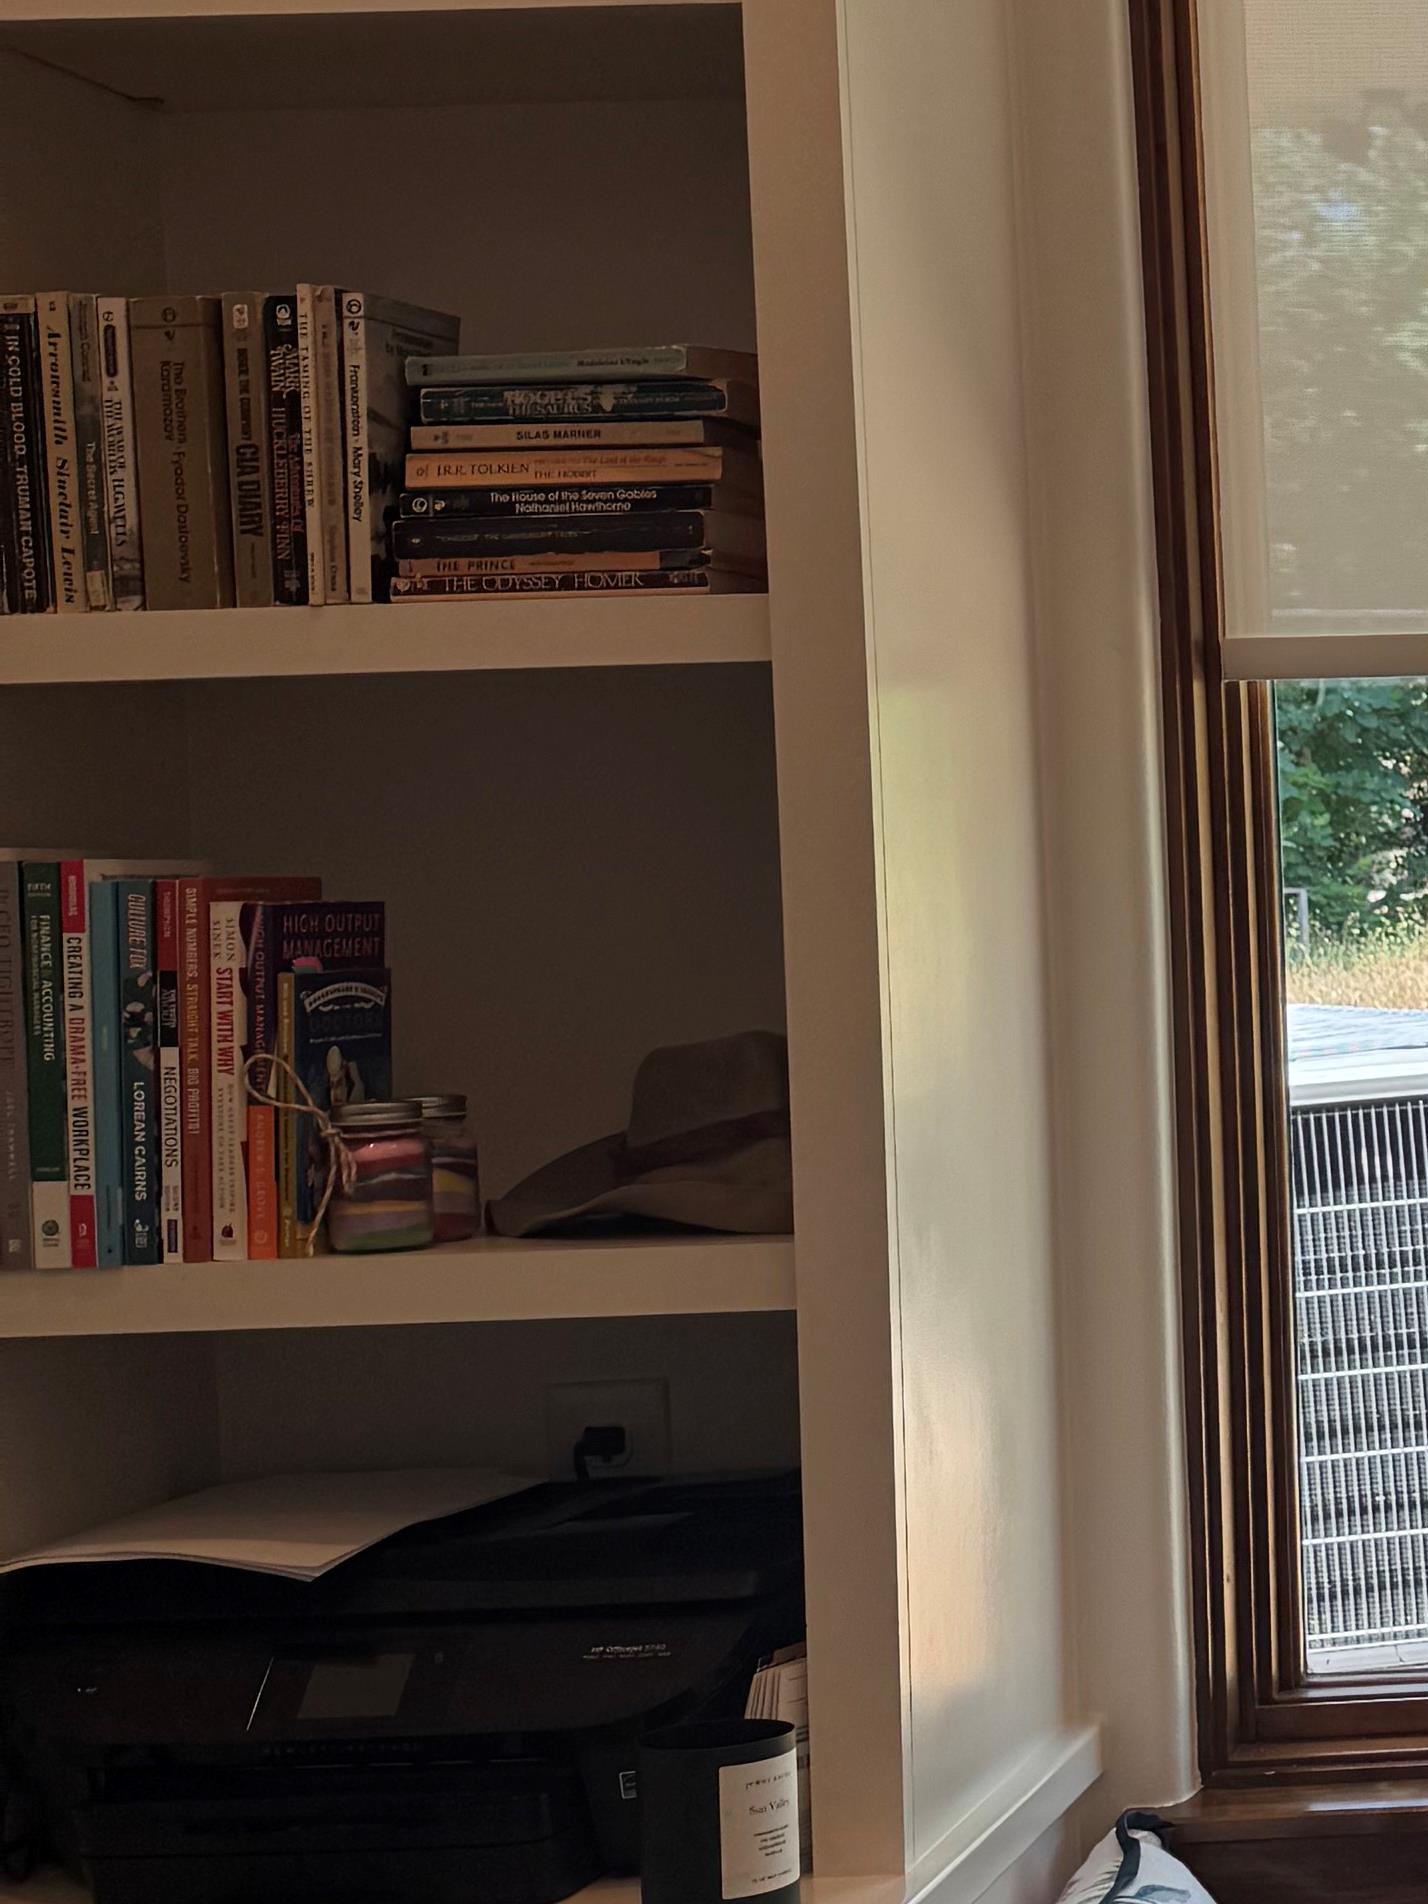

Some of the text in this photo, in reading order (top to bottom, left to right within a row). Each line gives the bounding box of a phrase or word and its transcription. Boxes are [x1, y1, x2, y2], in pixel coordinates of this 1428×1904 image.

[5, 335, 19, 352] IN
[7, 355, 22, 396] COLD
[516, 430, 601, 441] SILAS MARNER
[47, 326, 77, 603] Arrowsmith Sinclair Lewis
[349, 447, 363, 477] Mary
[470, 463, 529, 475] TOLKIEN
[14, 465, 32, 531] TRUMAN
[235, 444, 263, 537] CIA DIARY
[490, 493, 509, 502] The
[512, 492, 544, 502] House
[548, 491, 559, 501] of
[21, 538, 36, 599] CAPOTE
[445, 572, 643, 592] THE ODYSSEY HOMER
[468, 559, 515, 571] PRINCE
[225, 918, 236, 962] SIMON
[283, 912, 381, 934] HIGH OUTPUT
[67, 937, 85, 998] CREATING
[283, 937, 381, 959] MANAGEMENT
[39, 915, 56, 1061] FINANCE ACCOUNTING
[69, 1004, 85, 1012] A
[215, 968, 235, 1075] START WITH WHY
[132, 1081, 146, 1141] LOREAN
[162, 1066, 178, 1168] NEGOTIATIONS
[72, 1107, 91, 1191] WORKPLACE
[134, 1146, 147, 1201] CAIRNS
